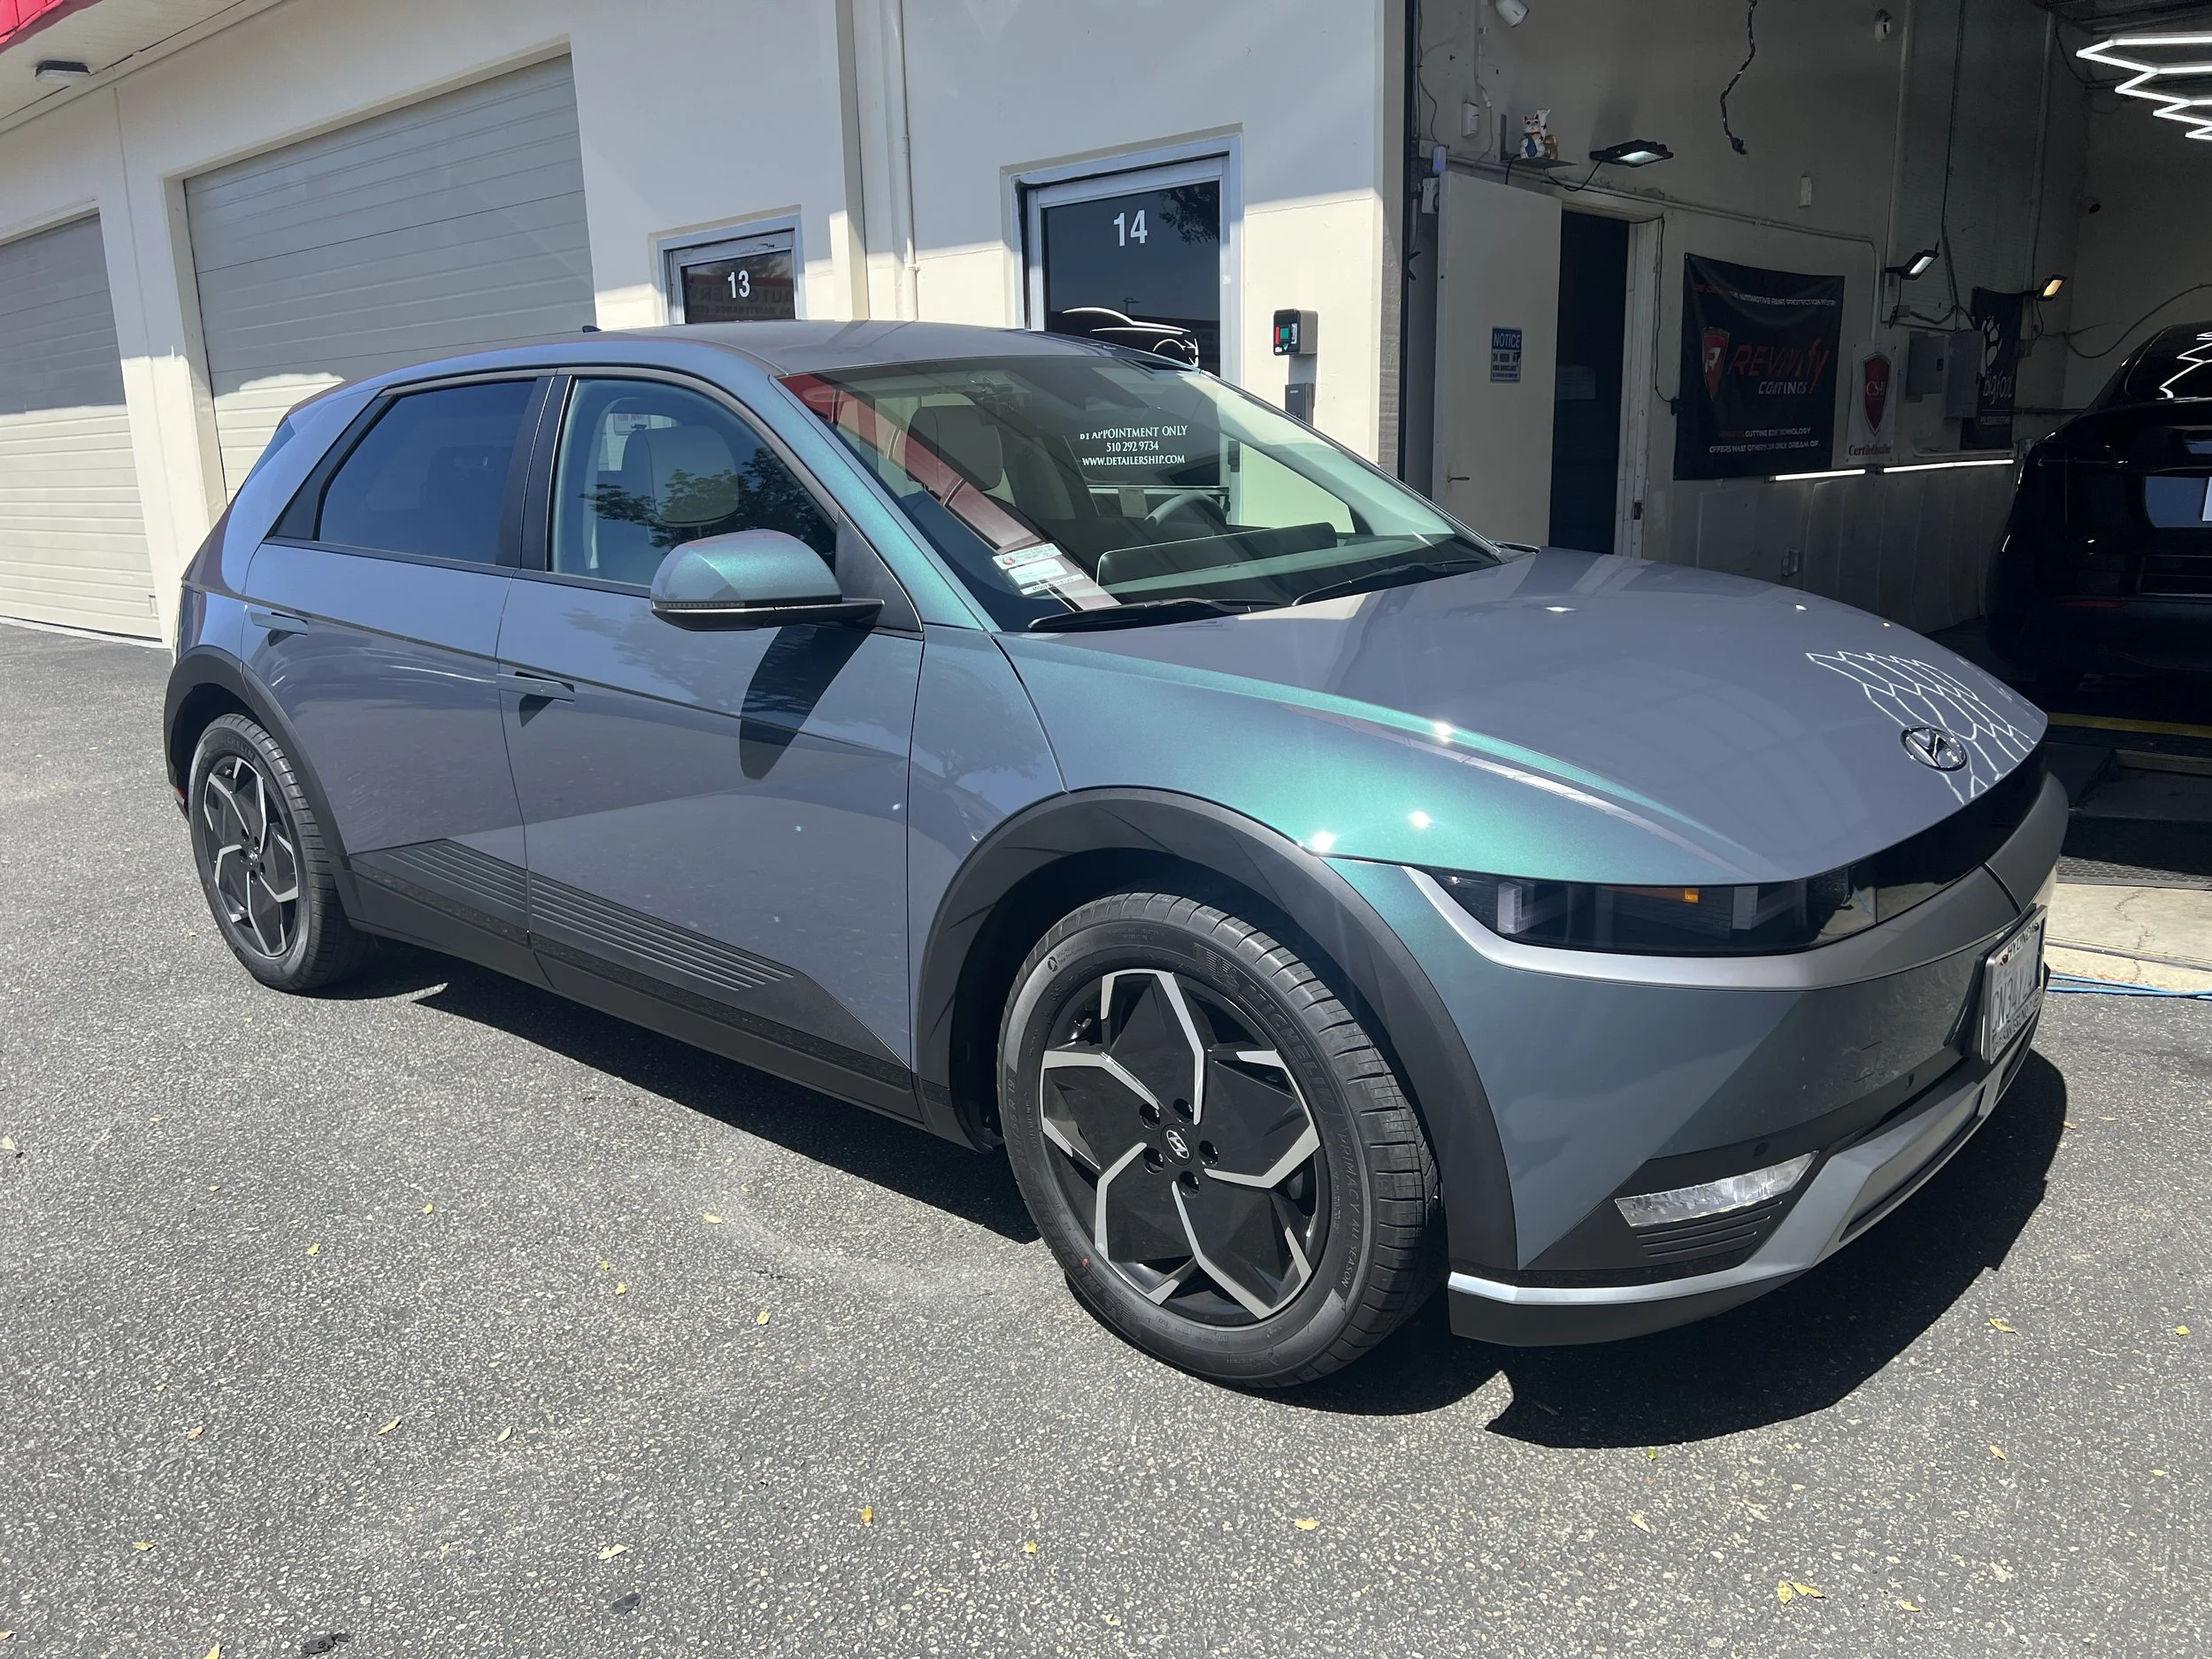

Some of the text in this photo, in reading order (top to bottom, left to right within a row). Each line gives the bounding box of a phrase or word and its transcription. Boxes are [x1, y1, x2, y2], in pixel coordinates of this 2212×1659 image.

[1113, 210, 1148, 247] 14
[727, 270, 751, 298] 13
[1494, 333, 1520, 348] NOTICE
[1758, 380, 1809, 396] COATINGS
[1091, 426, 1159, 440] APPOINTMENT
[1162, 425, 1187, 436] ONLY
[1106, 441, 1159, 452] 510 292 9734
[1709, 445, 1732, 454] OFFERS
[1081, 455, 1186, 466] WWW.DETAILERSHIP.COM
[1007, 1078, 1016, 1094] 19
[1337, 1132, 1361, 1289] PRIMACY ALL SEASON
